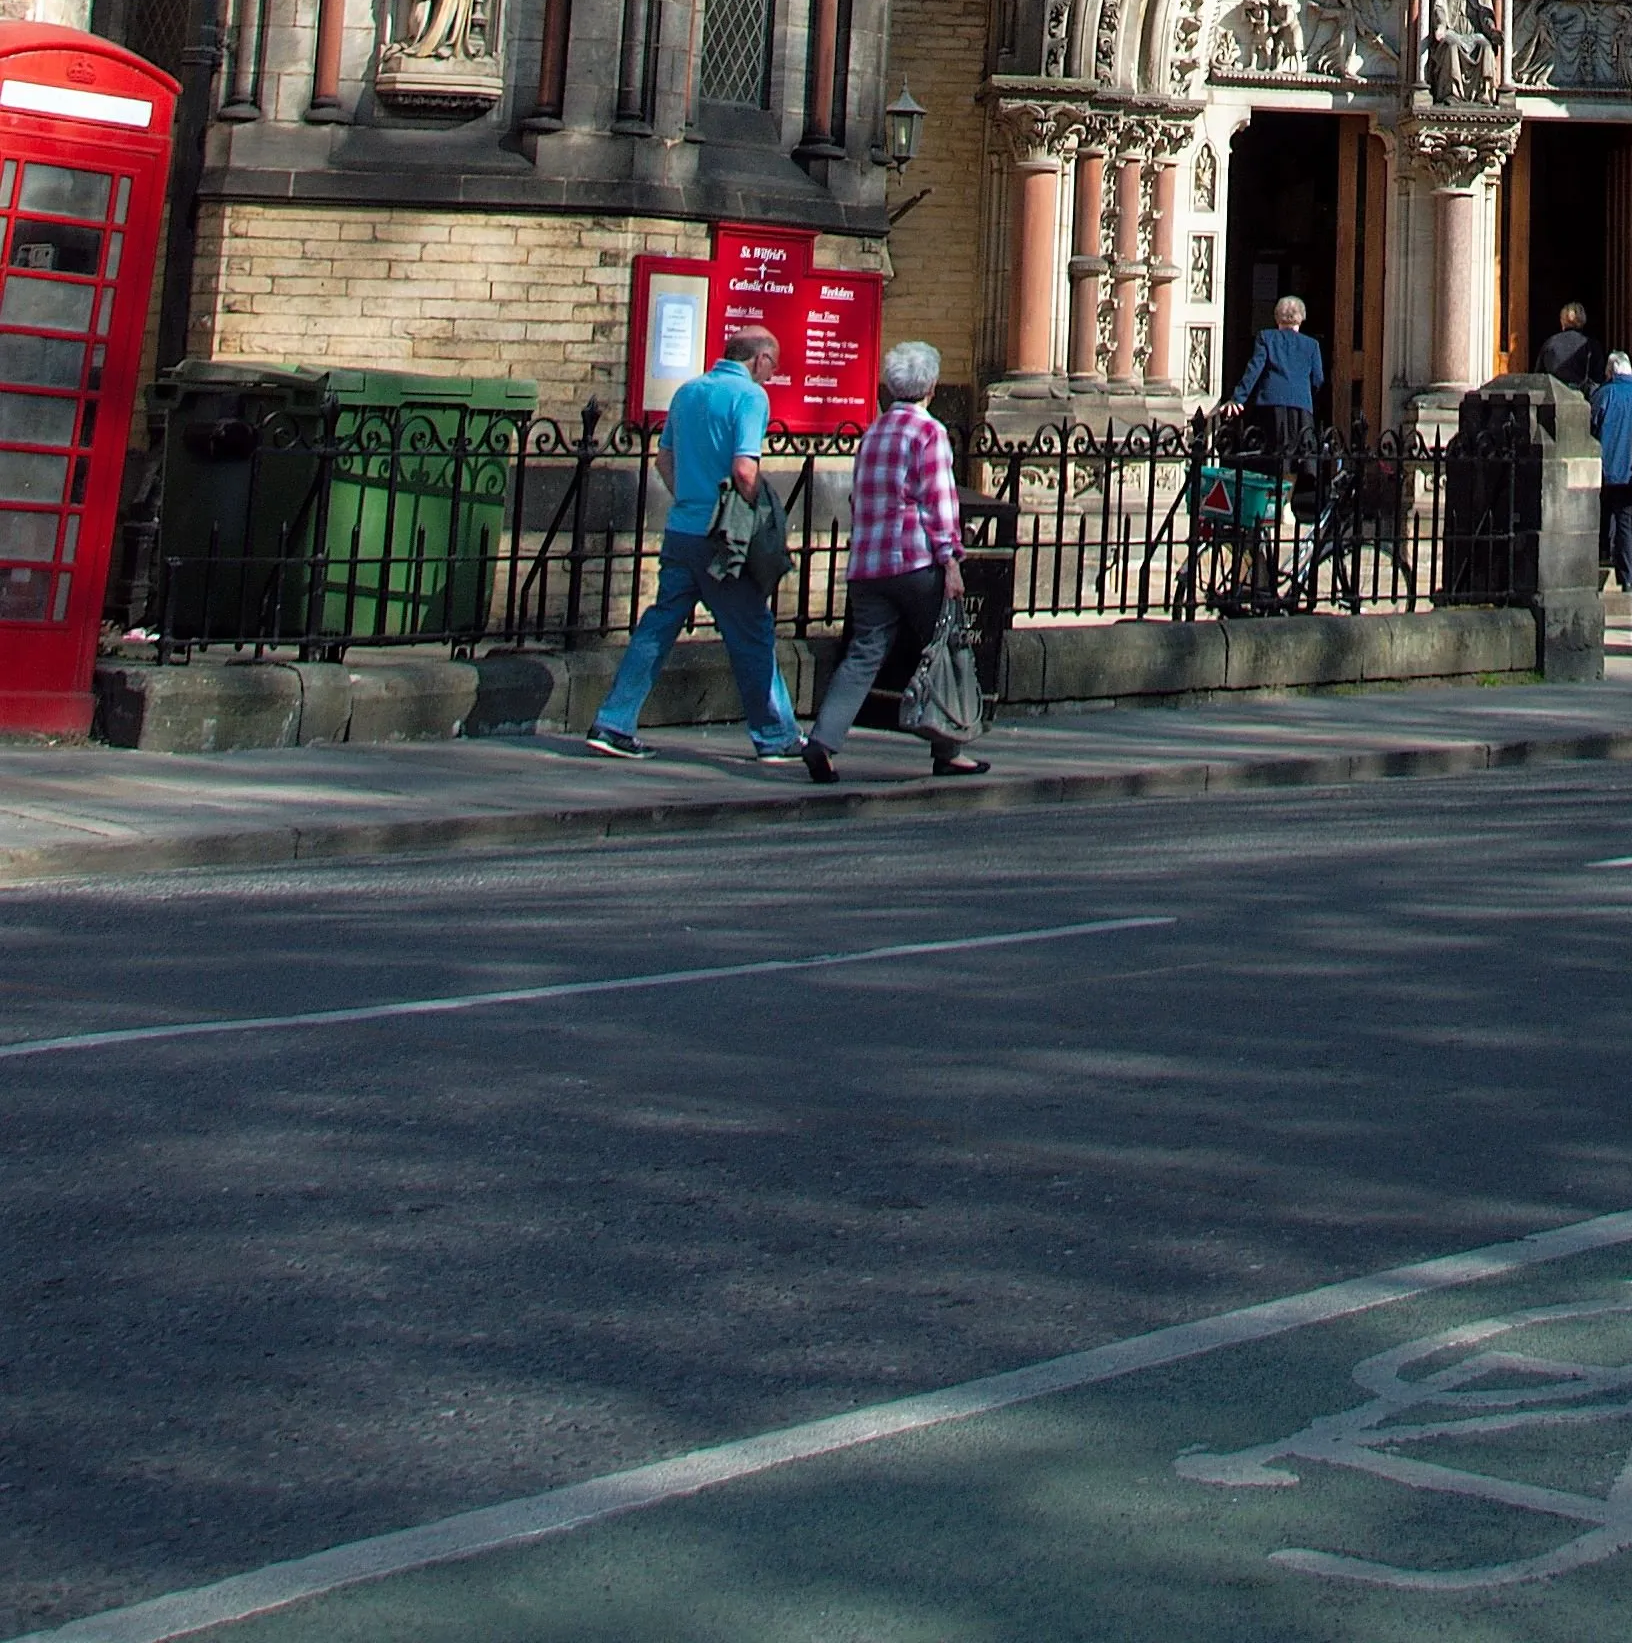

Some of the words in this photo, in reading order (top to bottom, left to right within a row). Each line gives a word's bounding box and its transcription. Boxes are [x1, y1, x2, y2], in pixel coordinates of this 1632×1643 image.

[753, 247, 787, 262] Wilfrid's
[729, 277, 762, 292] Catholic
[764, 281, 794, 294] Church
[821, 285, 854, 299] Weekdays
